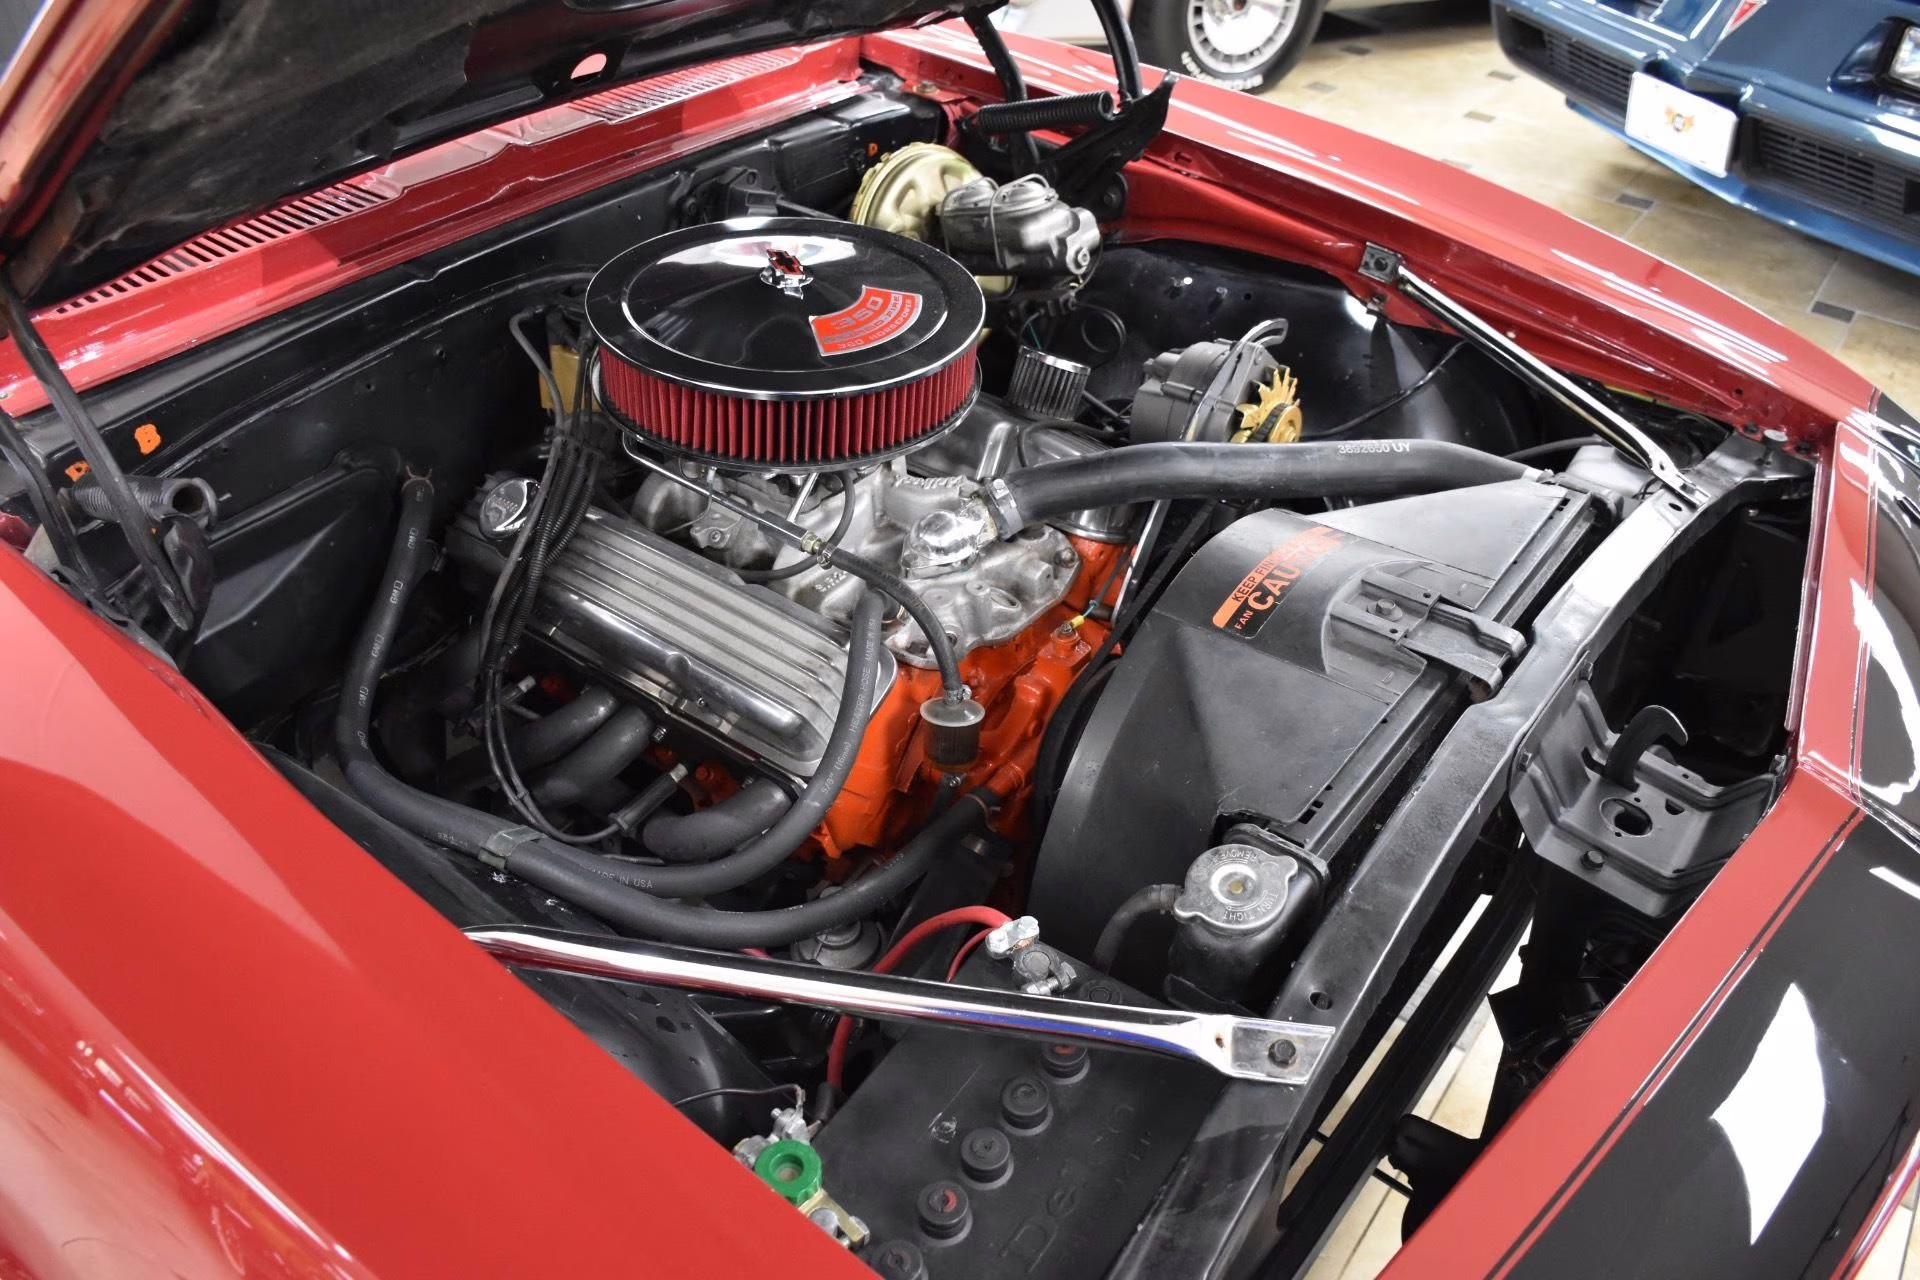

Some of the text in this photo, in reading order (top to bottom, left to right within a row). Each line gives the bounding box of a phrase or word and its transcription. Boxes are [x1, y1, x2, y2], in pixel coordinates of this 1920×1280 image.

[831, 296, 884, 329] 350
[1231, 576, 1257, 603] KEEP
[1235, 610, 1254, 630] FAN
[849, 694, 866, 733] HEATER
[860, 667, 871, 691] HOSE
[633, 878, 653, 889] USA
[1223, 911, 1256, 921] TIGHT
